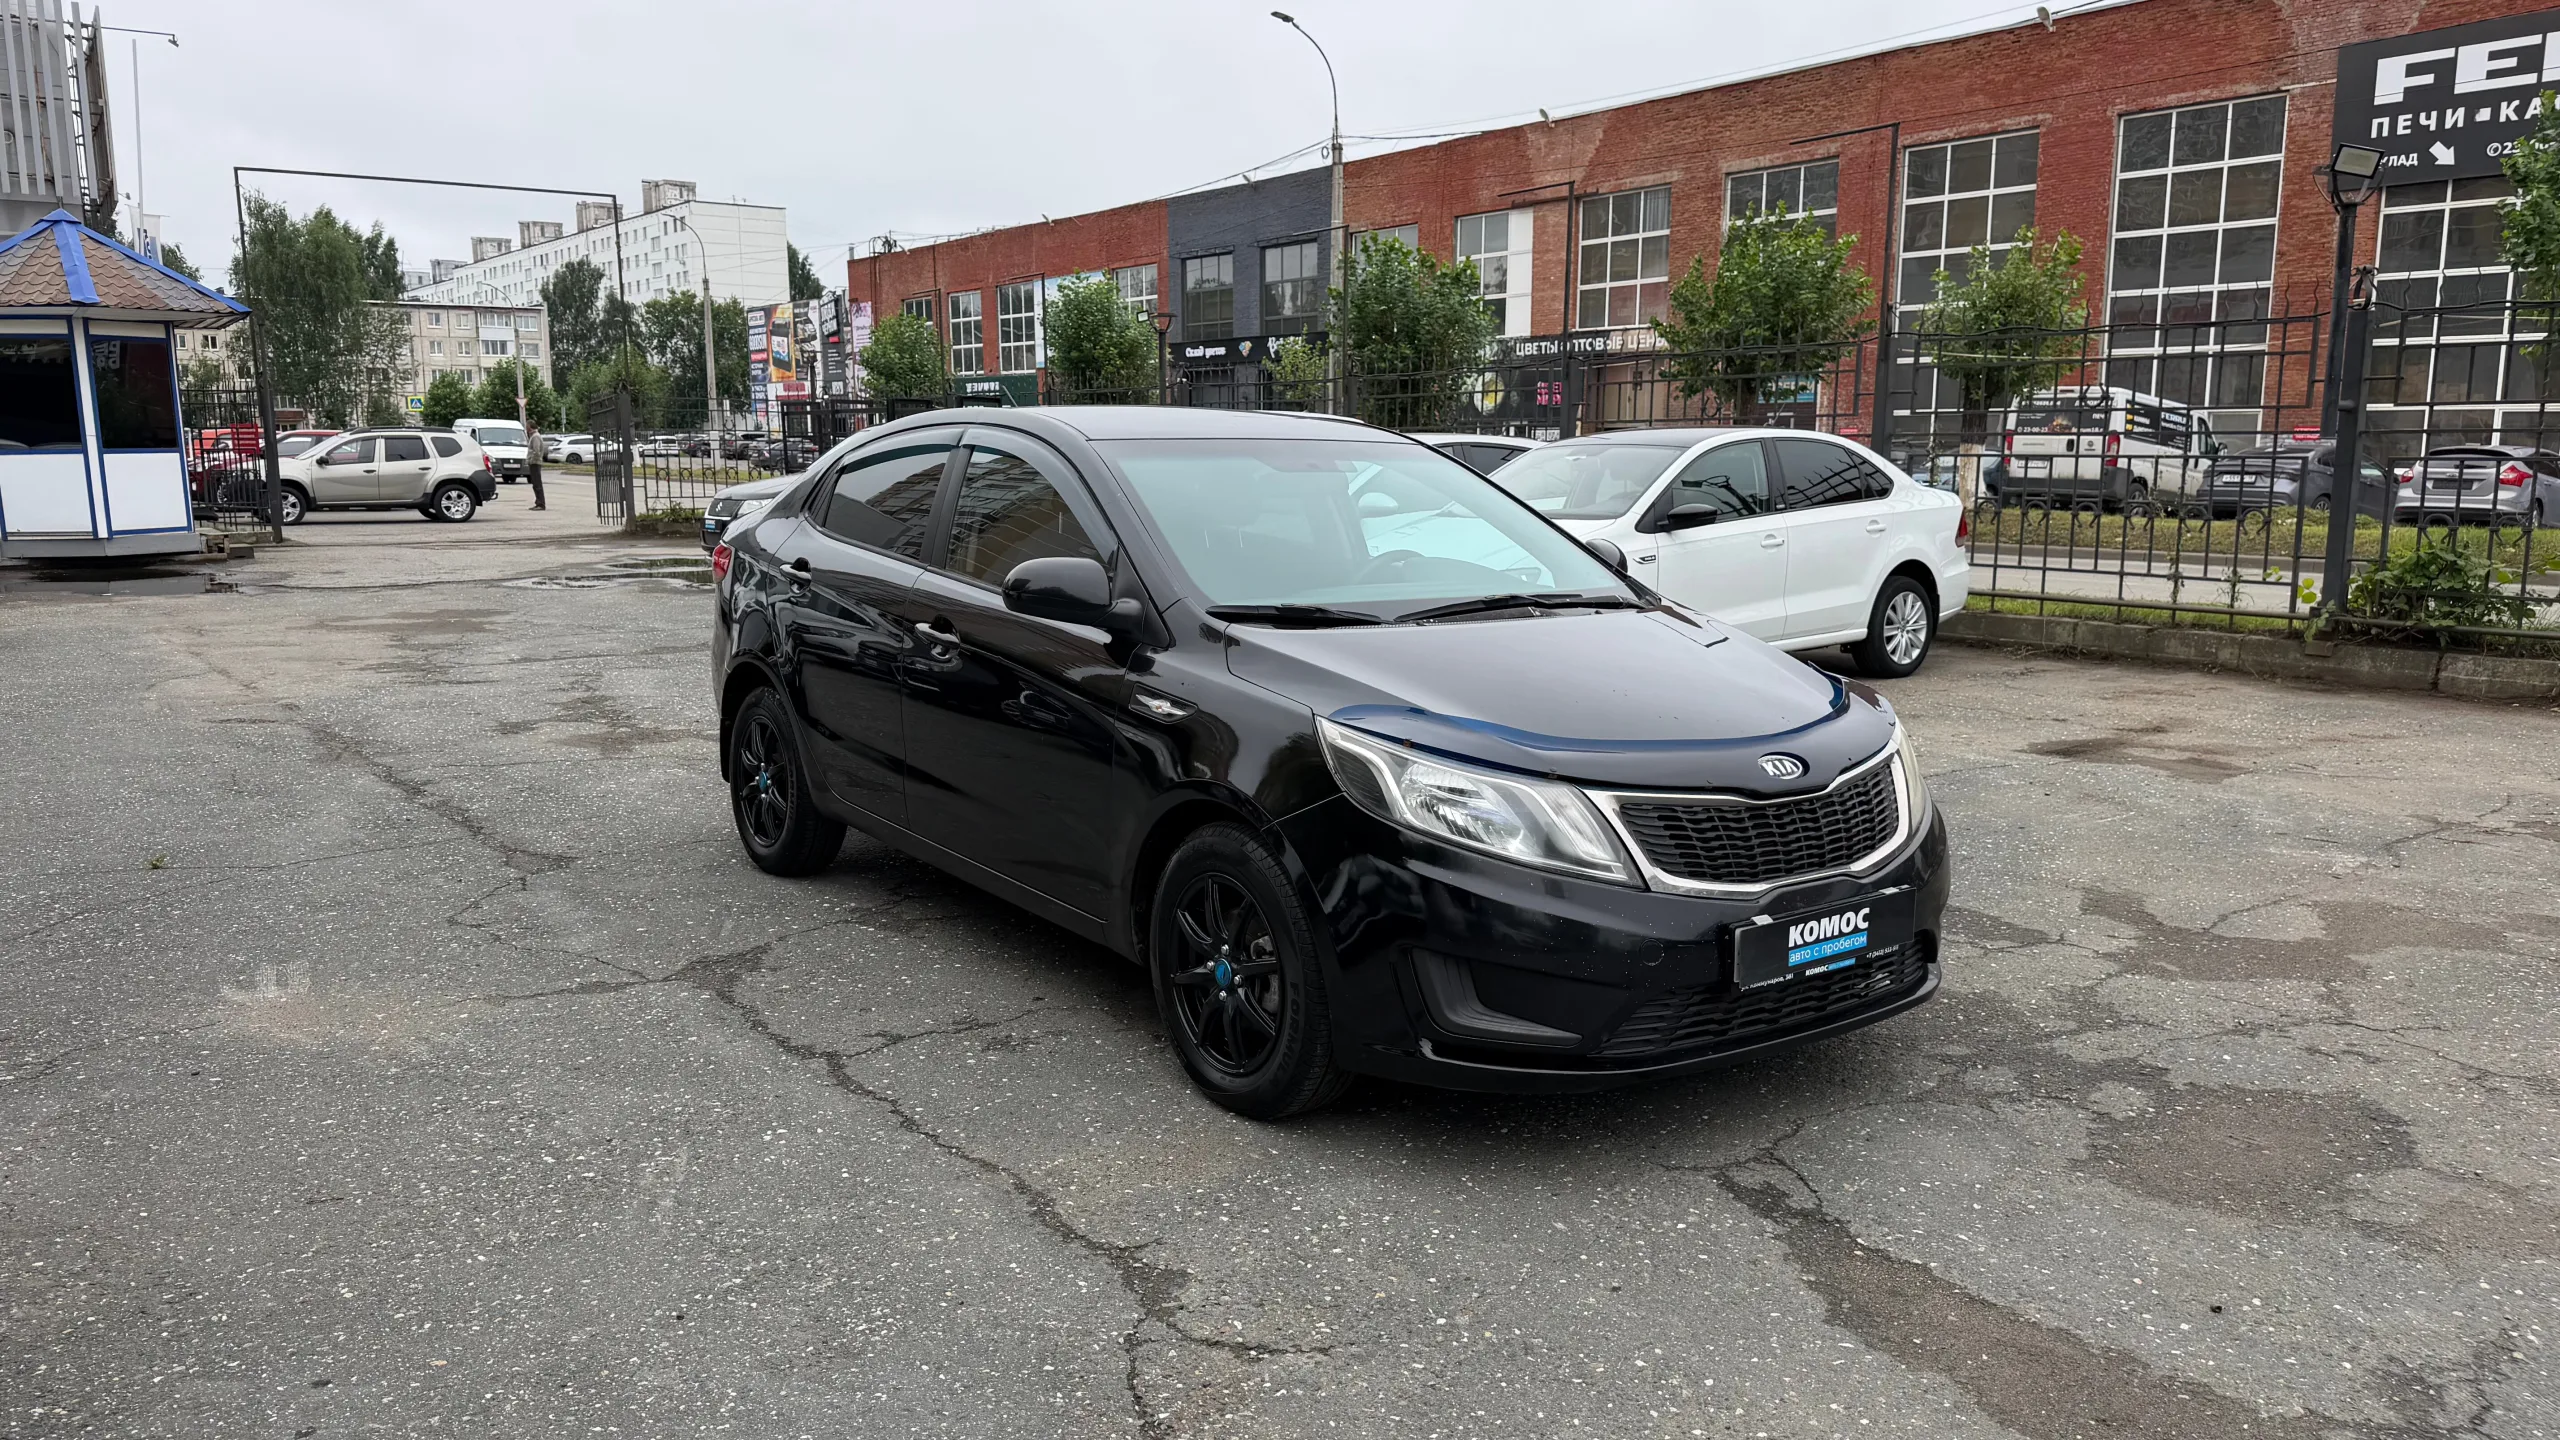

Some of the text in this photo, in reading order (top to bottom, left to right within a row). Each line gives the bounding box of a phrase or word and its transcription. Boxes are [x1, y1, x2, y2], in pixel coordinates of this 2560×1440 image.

[2374, 30, 2560, 105] FE
[2370, 95, 2560, 139] ПЕЧИ КА
[1516, 340, 1558, 357] ЦВЕТЫ
[2161, 411, 2191, 424] FERRU
[1761, 759, 1798, 777] KIA
[1788, 907, 1870, 947] КОМОС
[1789, 934, 1867, 963] авто с пробегом
[1805, 964, 1829, 977] КОМОС
